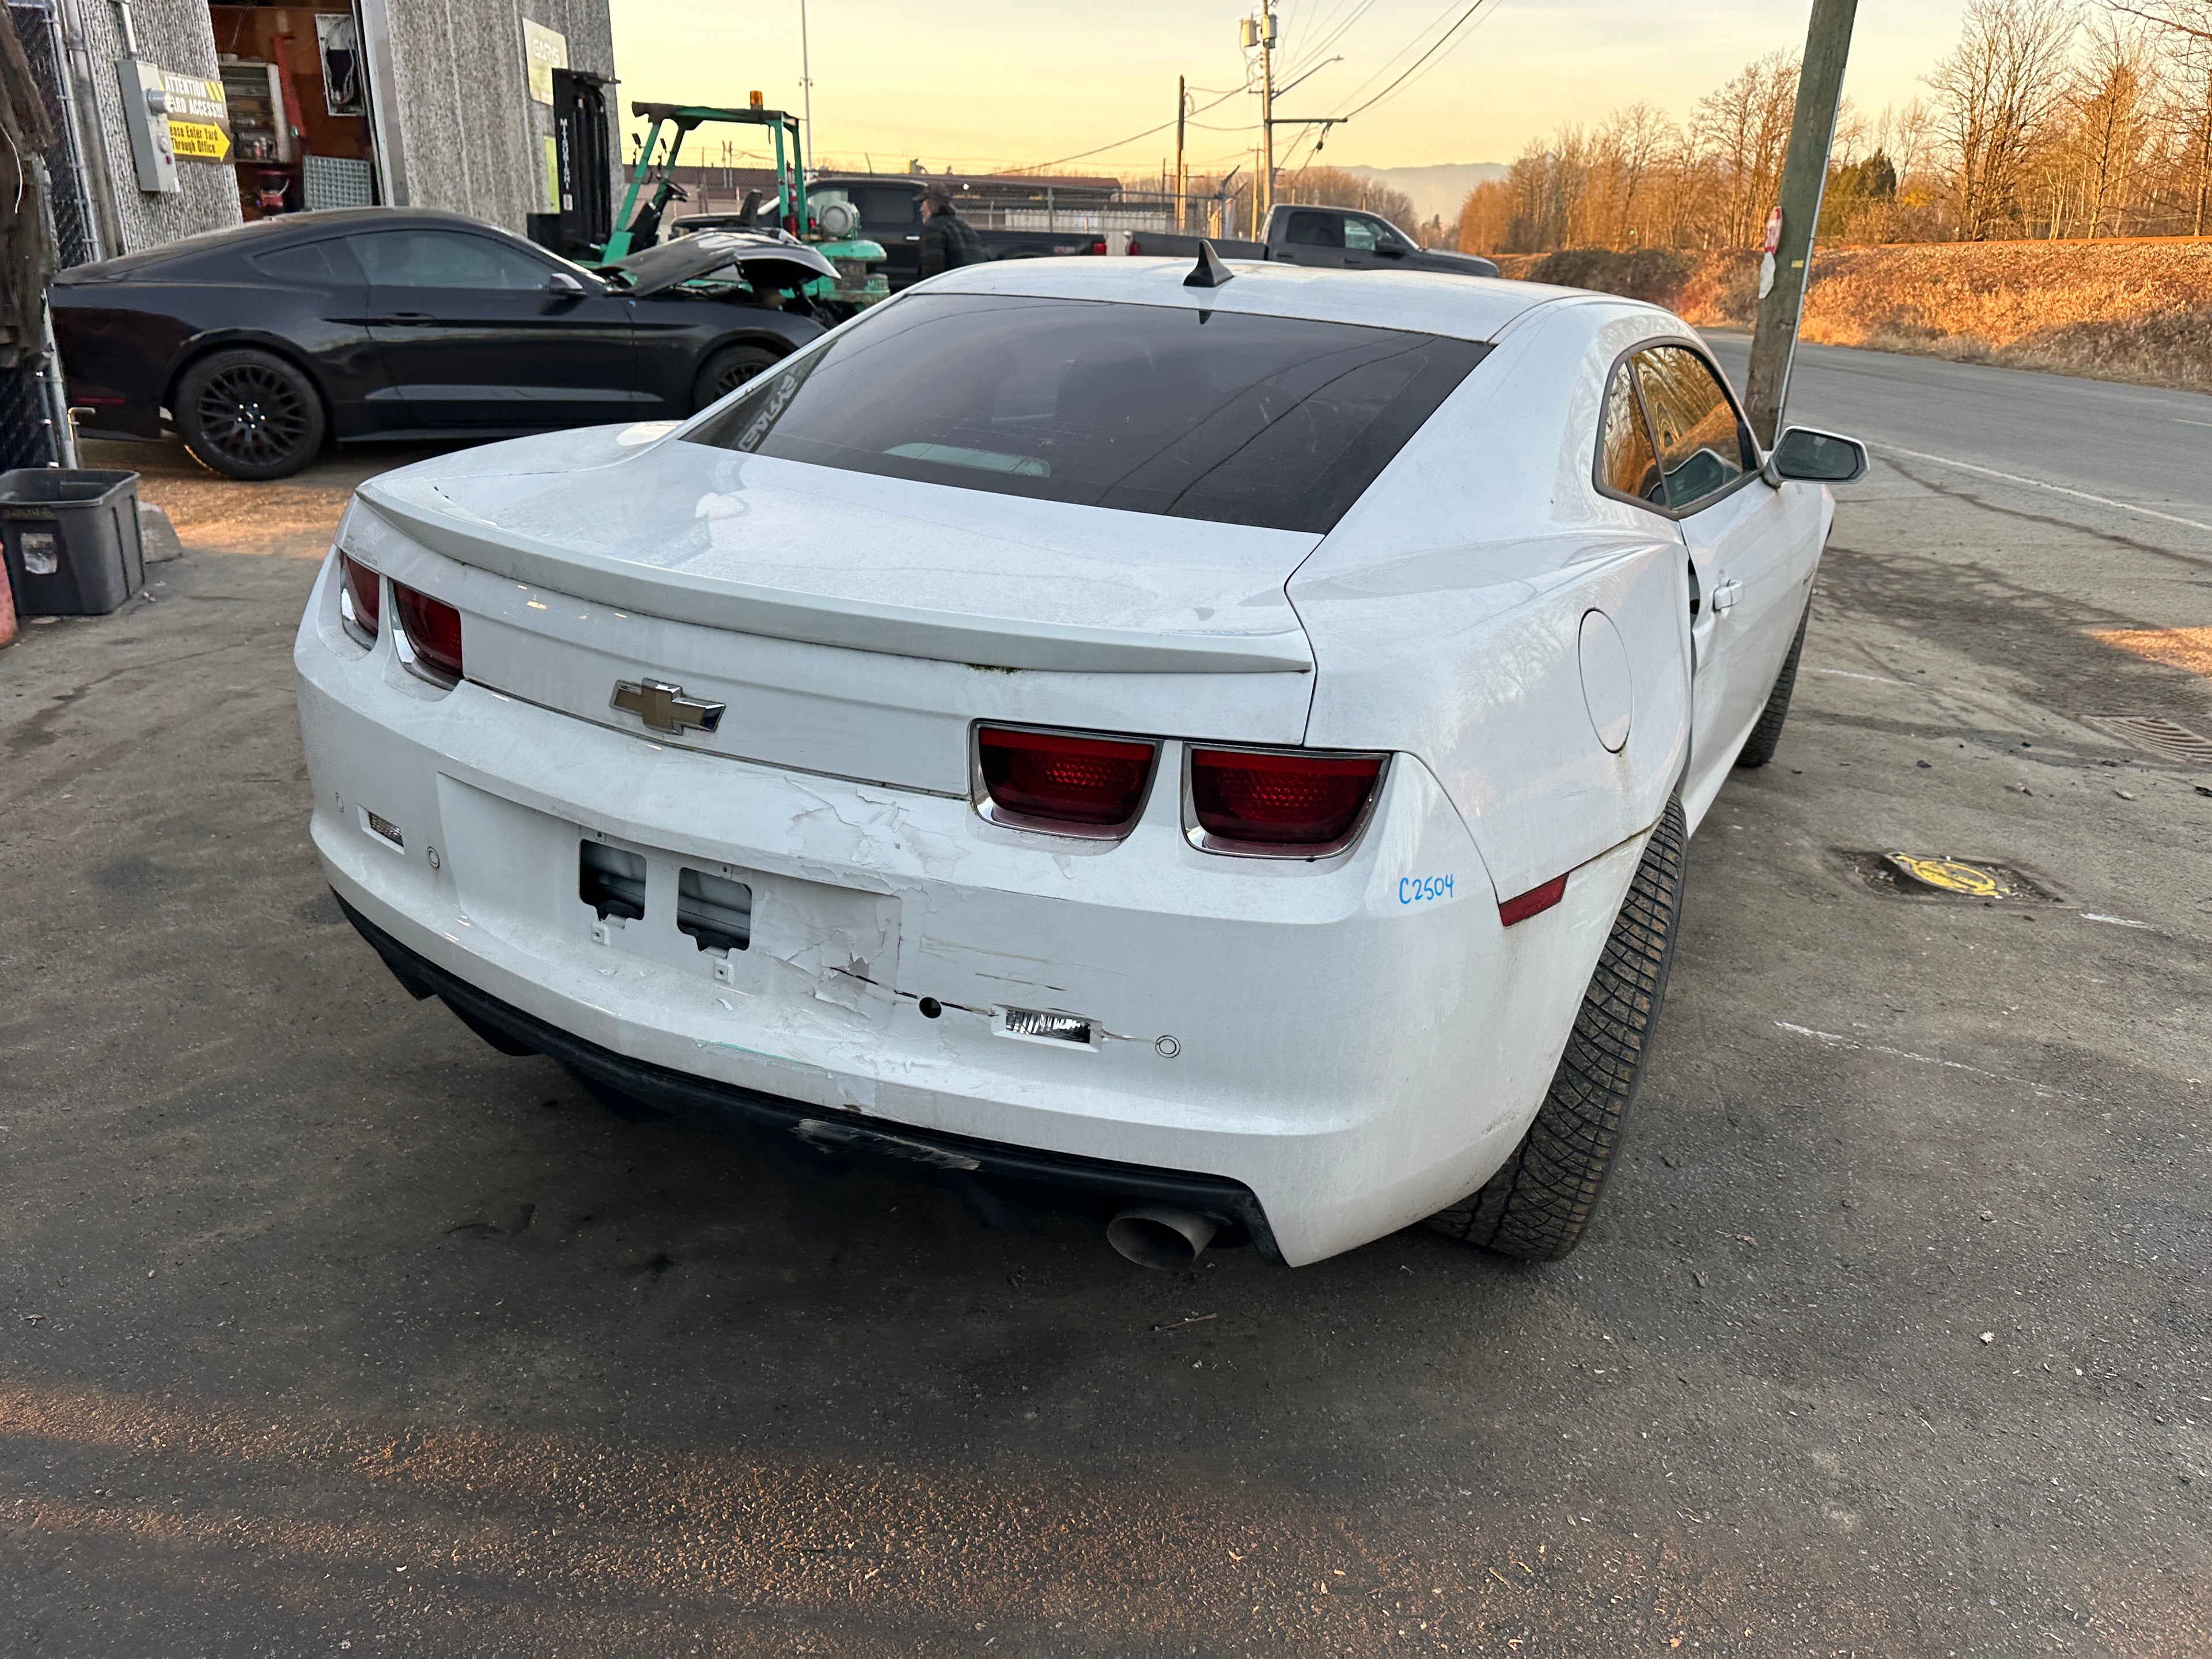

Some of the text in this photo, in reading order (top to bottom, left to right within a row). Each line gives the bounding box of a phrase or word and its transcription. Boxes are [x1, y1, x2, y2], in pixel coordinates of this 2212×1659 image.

[164, 75, 207, 98] ATTENTION
[172, 95, 224, 119] ARD ACCESS!!!
[185, 125, 203, 139] Enter
[204, 127, 218, 141] Yard
[171, 137, 216, 154] Through Office
[1399, 873, 1455, 905] C2504
